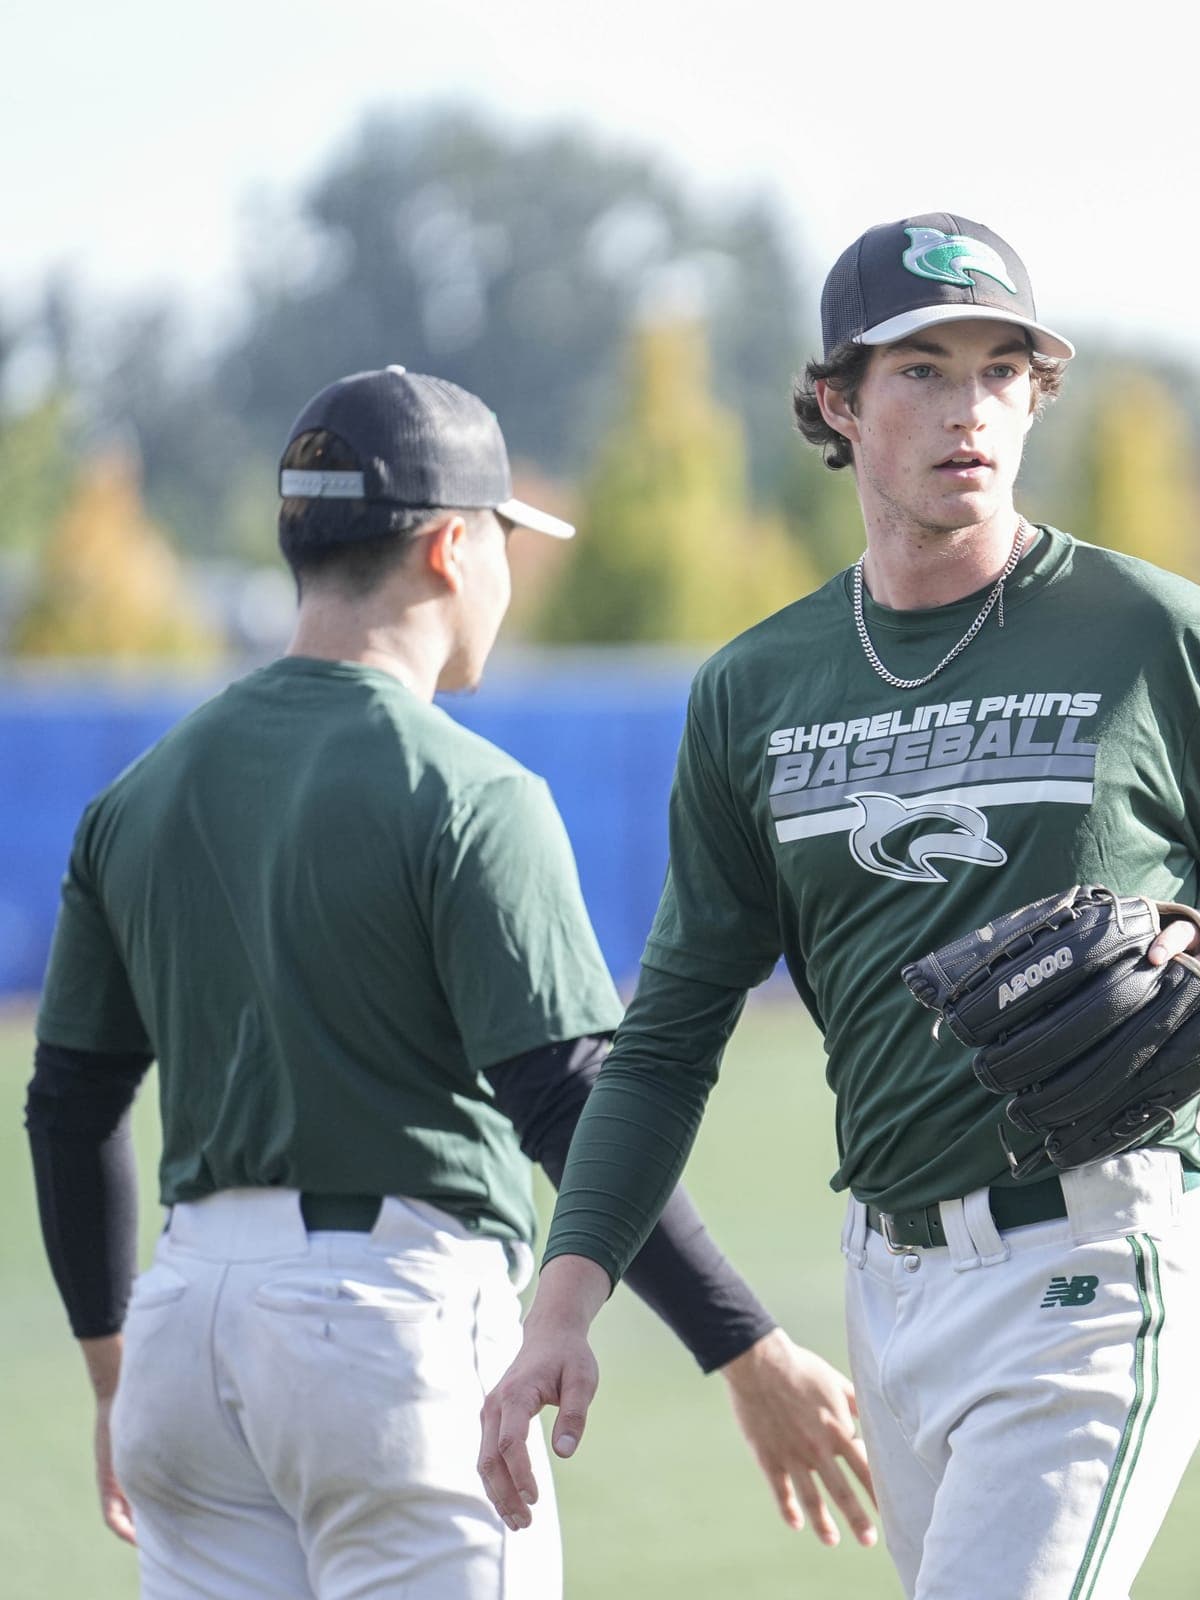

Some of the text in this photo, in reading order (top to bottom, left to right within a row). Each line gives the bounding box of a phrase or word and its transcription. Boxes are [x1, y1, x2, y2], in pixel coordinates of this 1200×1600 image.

[768, 693, 1102, 756] SHORELINE PHINS
[769, 717, 1099, 795] BASEBALL
[998, 946, 1074, 1010] A2000
[1040, 1275, 1099, 1308] NB
